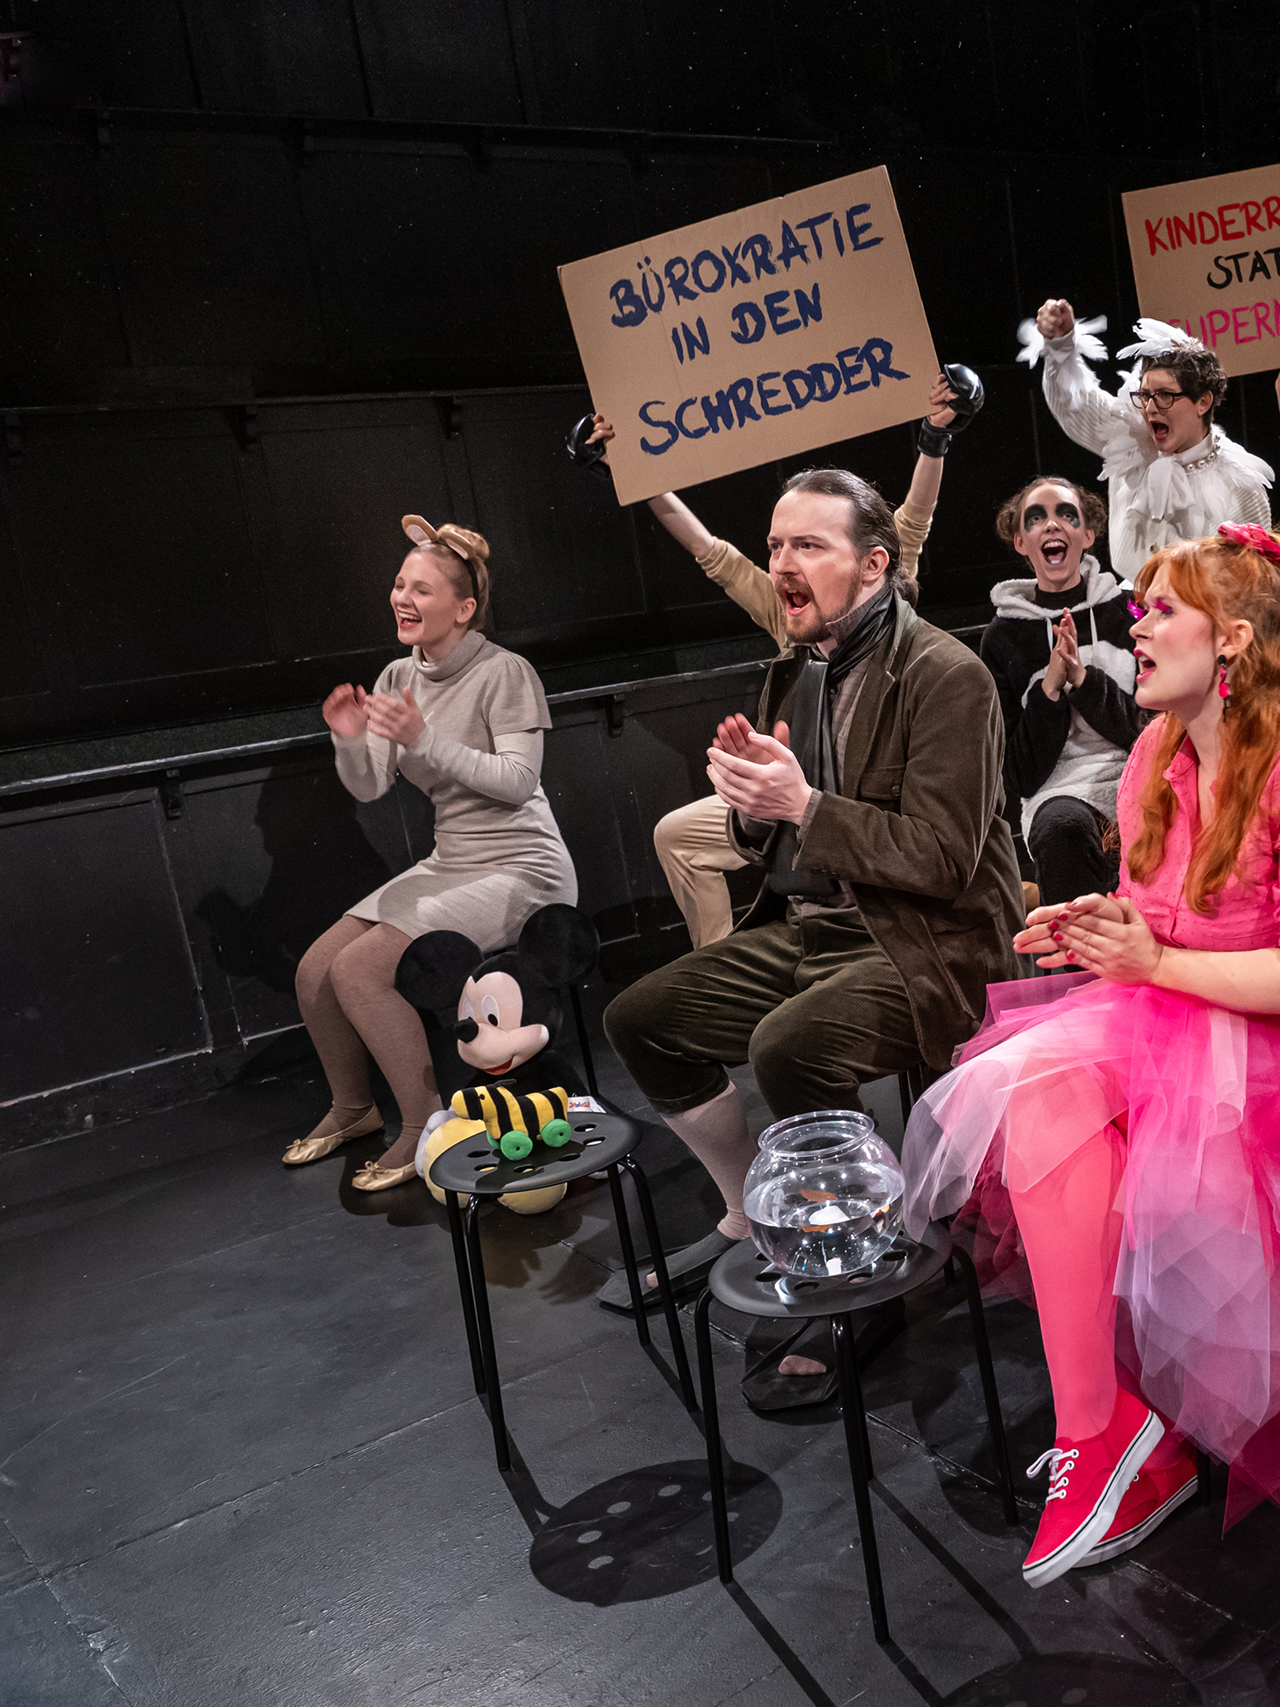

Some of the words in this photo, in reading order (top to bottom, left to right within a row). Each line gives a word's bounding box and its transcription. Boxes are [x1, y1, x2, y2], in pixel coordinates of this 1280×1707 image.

[609, 203, 886, 328] BÜROKRATIE
[670, 315, 710, 365] IN
[730, 282, 823, 345] DEN
[638, 336, 911, 456] SCHREDDER
